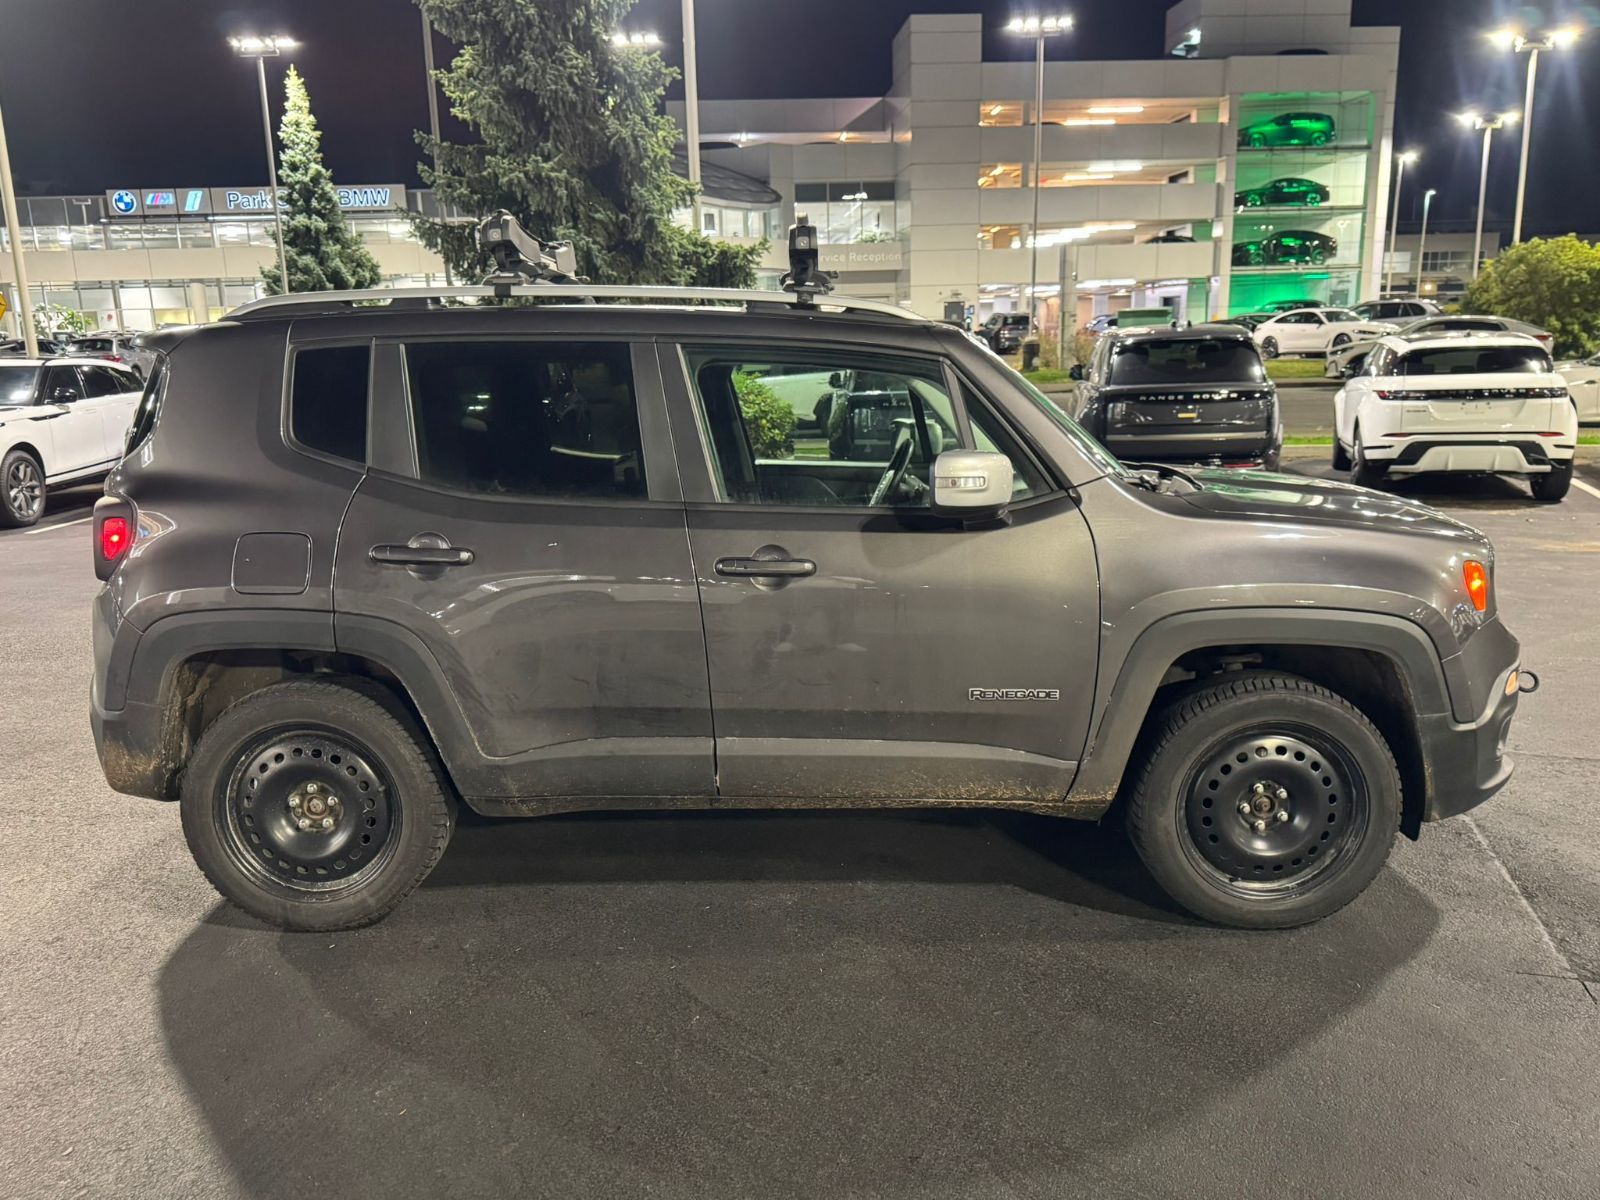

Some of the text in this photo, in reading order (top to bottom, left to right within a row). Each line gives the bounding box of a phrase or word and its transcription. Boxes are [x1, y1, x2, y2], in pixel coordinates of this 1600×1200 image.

[227, 191, 272, 209] Park
[338, 189, 390, 207] BMW
[820, 252, 900, 263] rvice Reception
[968, 687, 1060, 701] RENEGADE
